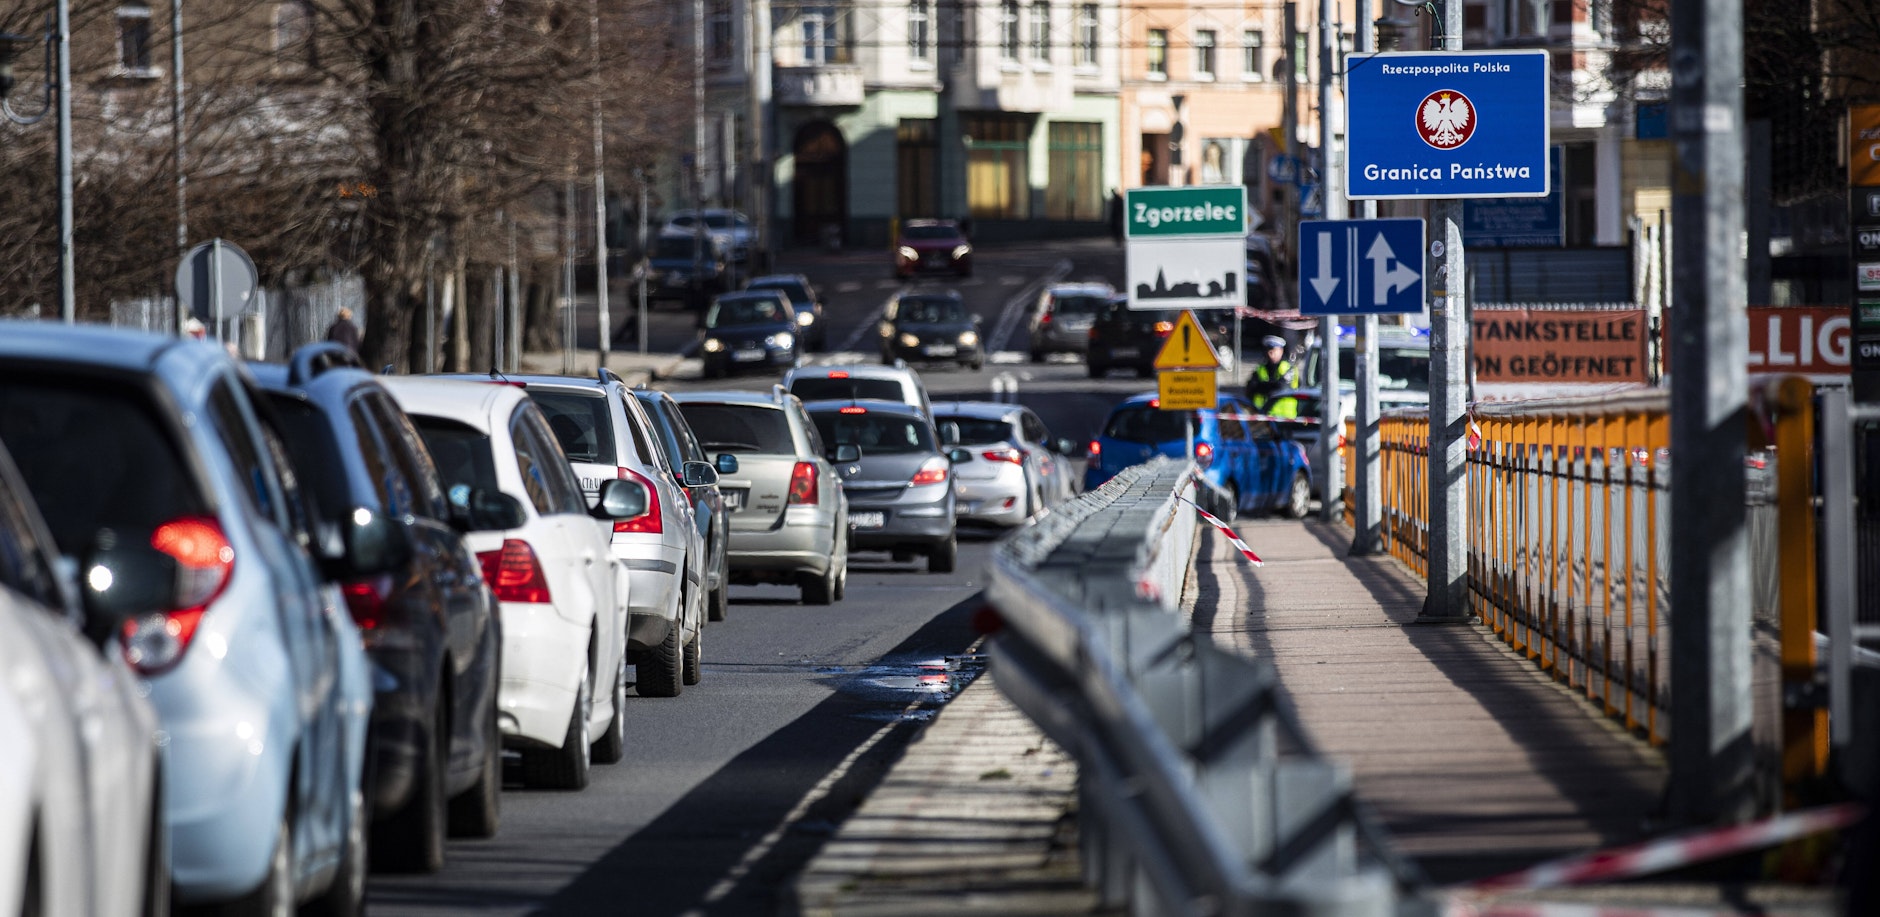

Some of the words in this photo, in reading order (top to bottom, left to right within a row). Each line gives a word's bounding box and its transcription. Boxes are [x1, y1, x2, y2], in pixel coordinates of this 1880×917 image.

[1382, 63, 1469, 76] Rzeczpospolita
[1473, 62, 1511, 73] Polska
[1364, 163, 1442, 181] Granica
[1450, 162, 1530, 180] Państwa
[1134, 201, 1237, 228] Zgorzelec
[1474, 319, 1637, 342] TANKSTELLE
[1509, 351, 1637, 377] GEÖFFNET
